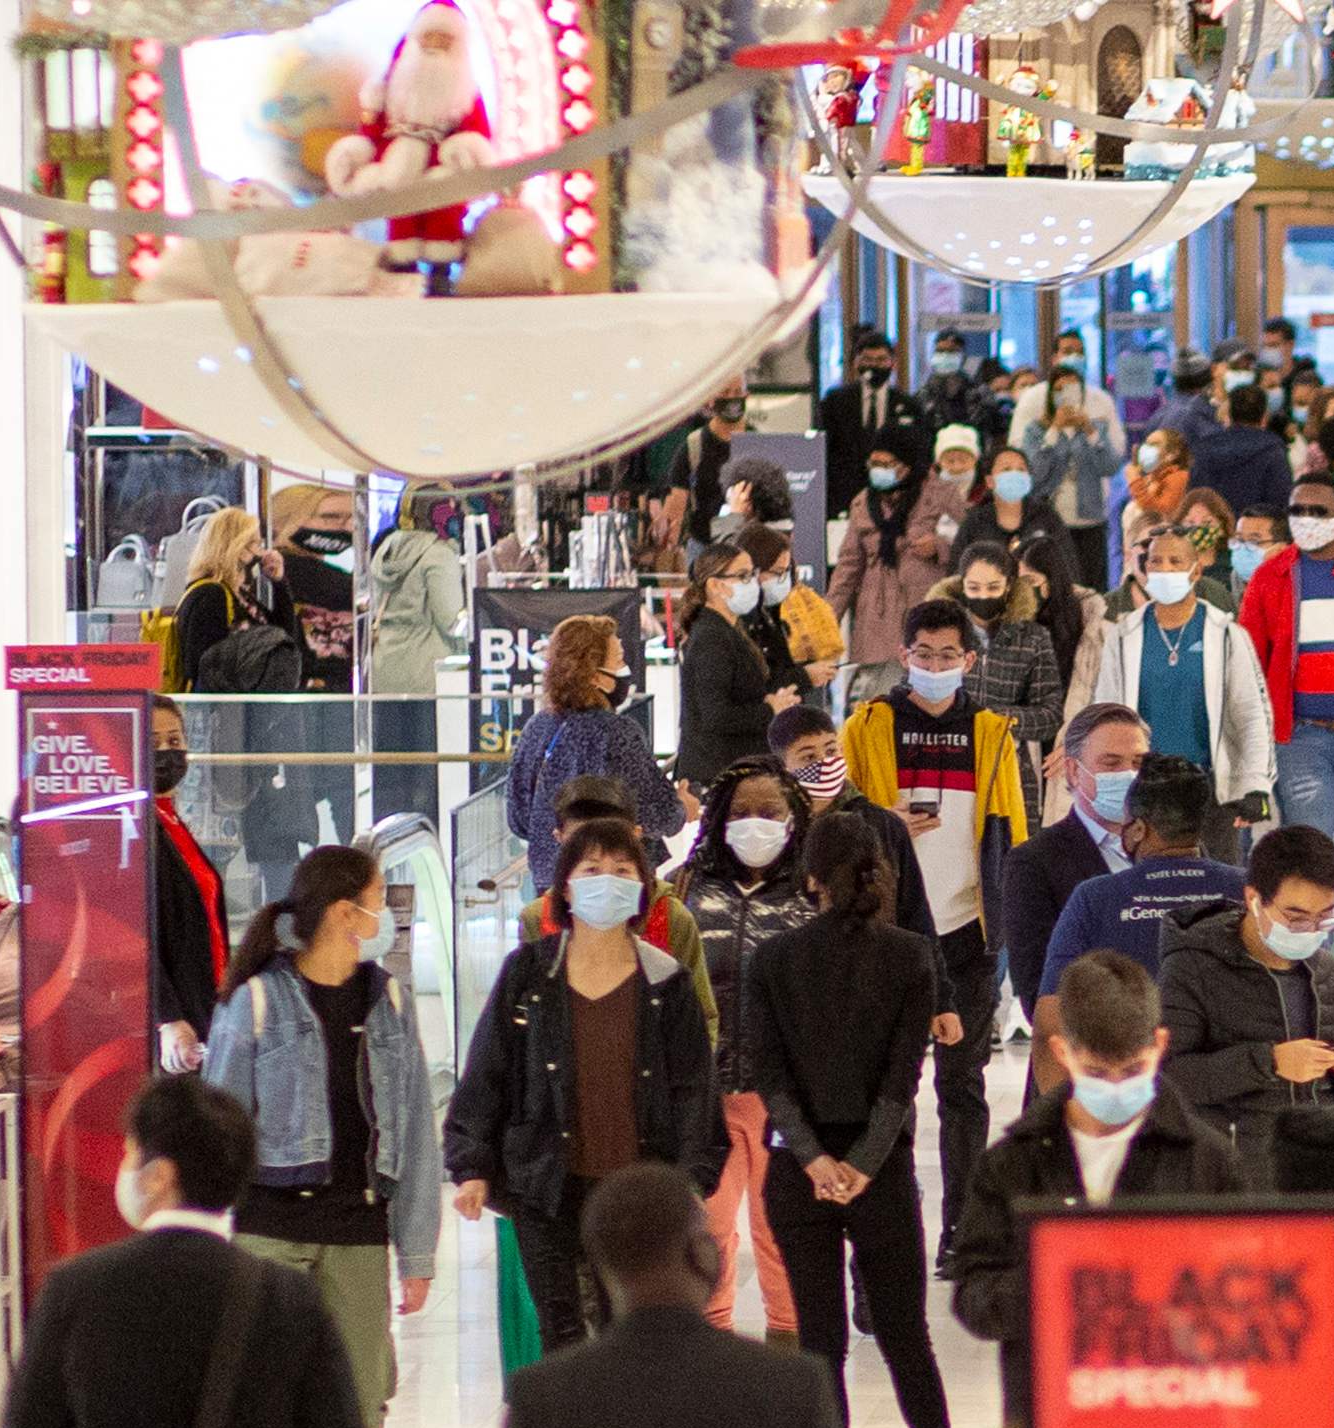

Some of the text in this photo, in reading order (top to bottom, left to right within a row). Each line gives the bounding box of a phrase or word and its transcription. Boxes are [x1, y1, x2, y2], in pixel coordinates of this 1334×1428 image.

[10, 667, 91, 683] SPECIAL
[33, 735, 93, 754] GIVE.
[48, 754, 116, 774] LOVE.
[34, 775, 134, 794] BELIEVE.
[1120, 905, 1170, 921] #Gene
[1069, 1261, 1310, 1312] BLACK
[1069, 1306, 1313, 1366] FRIDAY
[1069, 1365, 1261, 1409] SPECIAL
